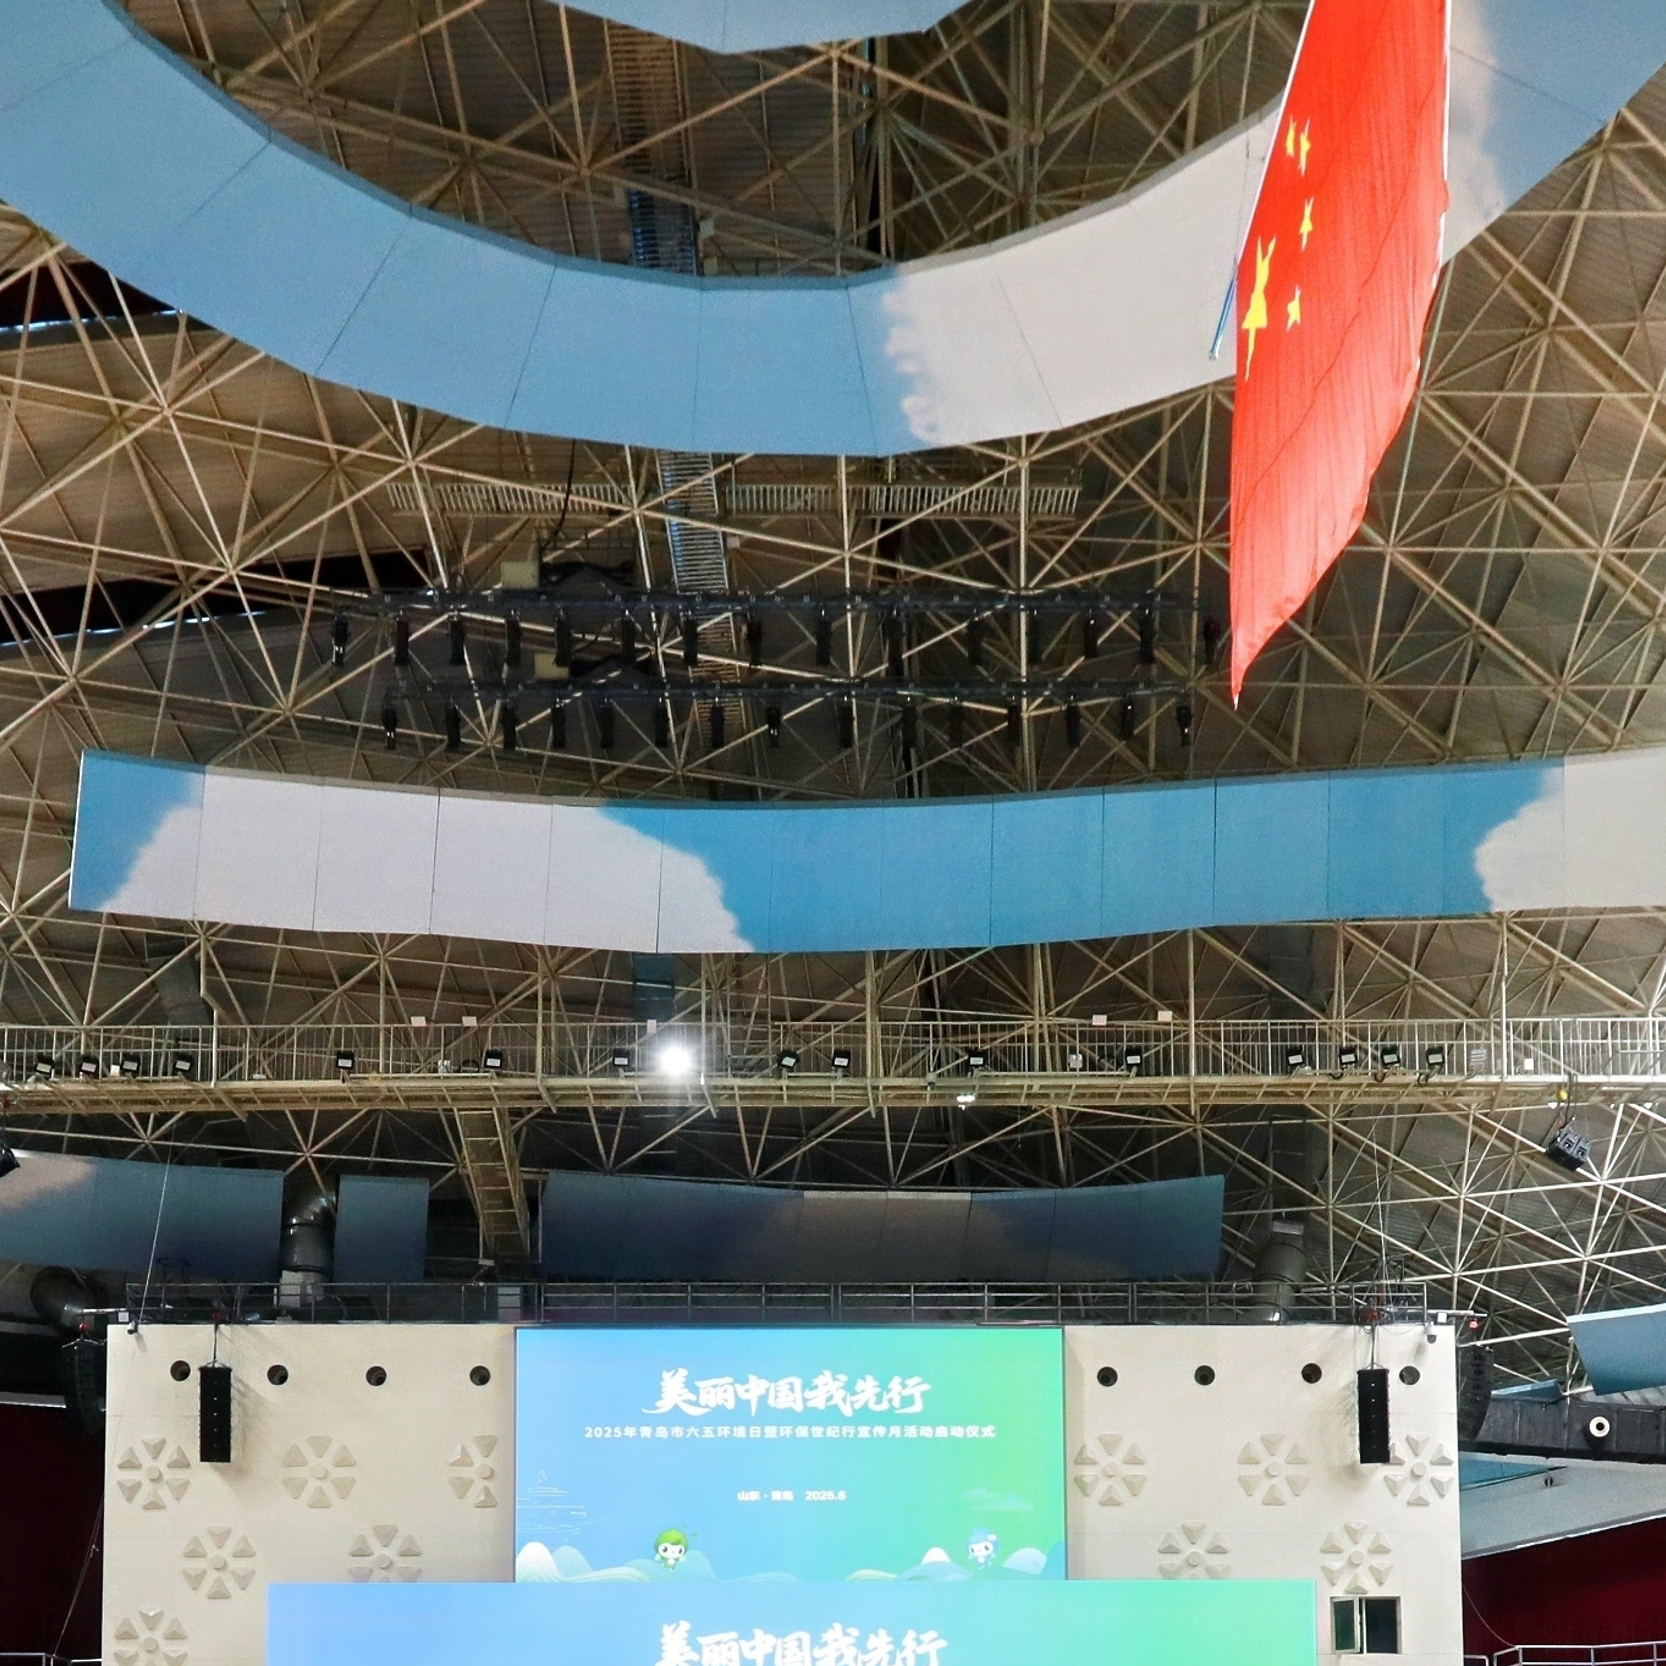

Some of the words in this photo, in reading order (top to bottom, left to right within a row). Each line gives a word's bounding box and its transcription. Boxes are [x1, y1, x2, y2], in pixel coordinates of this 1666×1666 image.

[642, 1368, 931, 1416] 美丽中国我先行
[585, 1424, 995, 1438] 2025年青岛市六五环境日暨环保世纪行宣传月活动启动仪式
[805, 1490, 846, 1501] 2025.6
